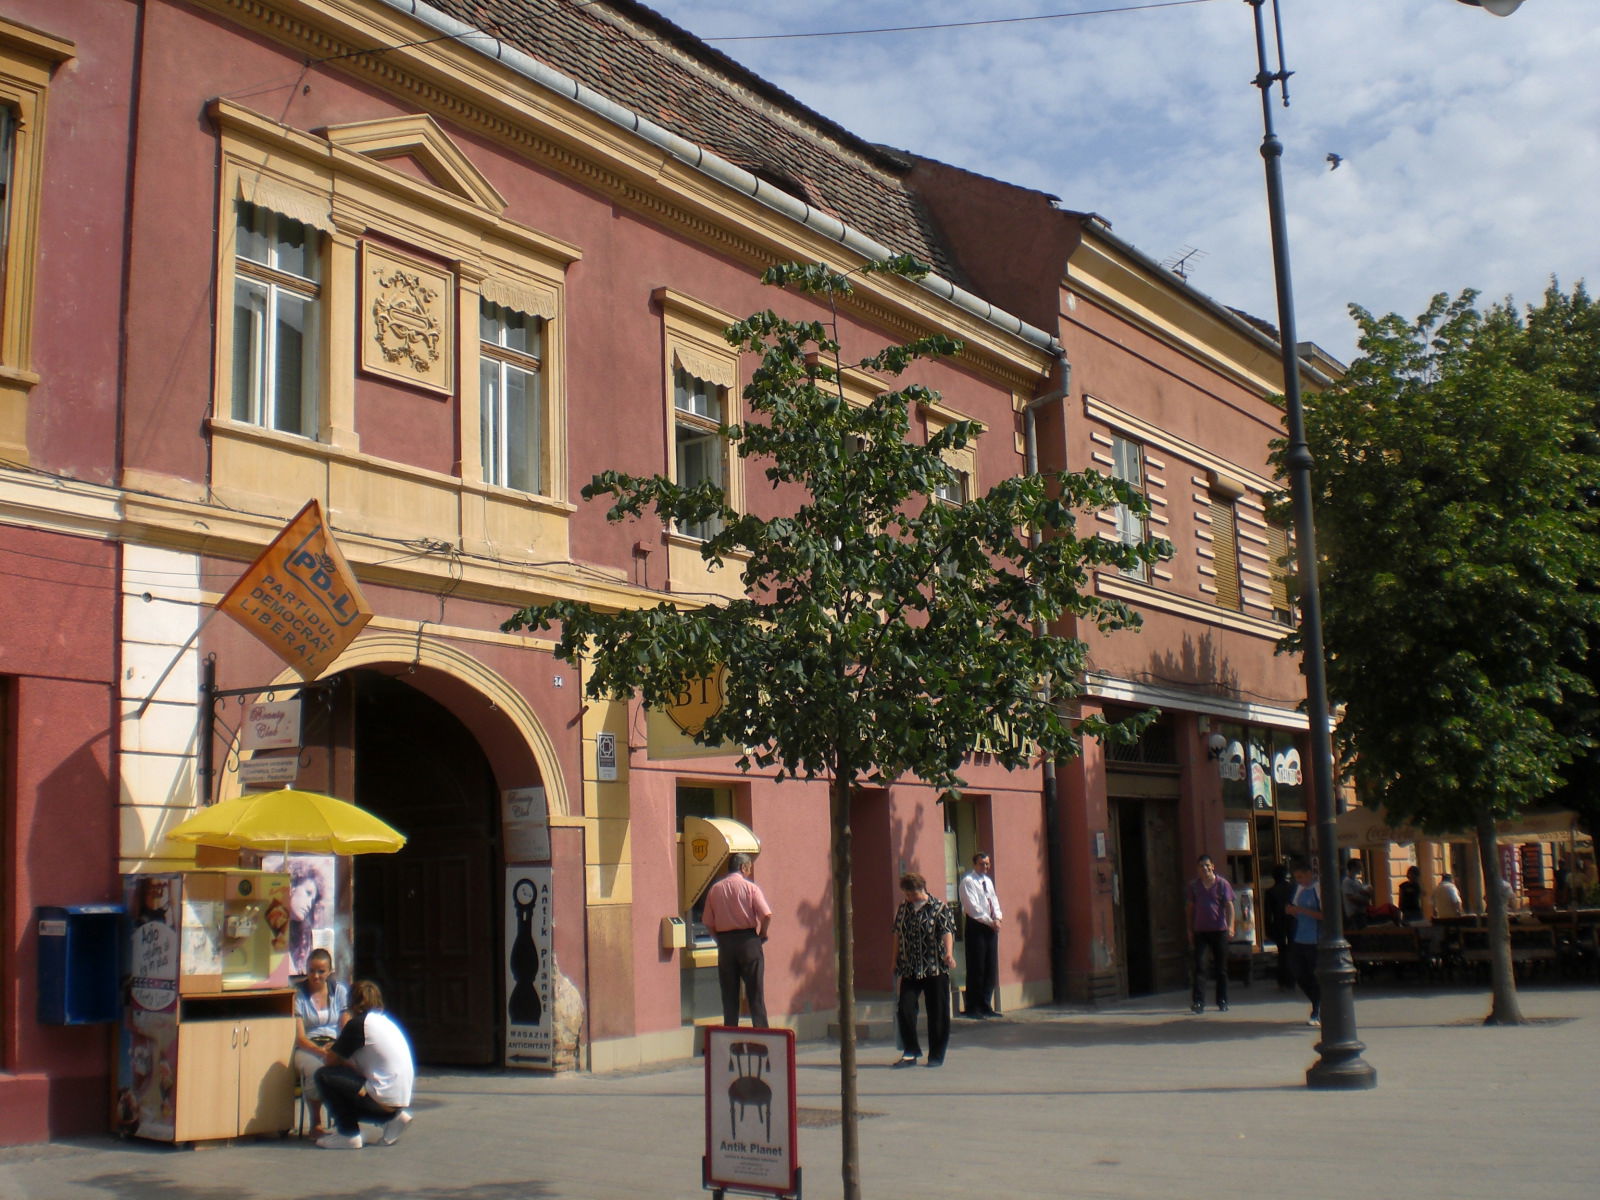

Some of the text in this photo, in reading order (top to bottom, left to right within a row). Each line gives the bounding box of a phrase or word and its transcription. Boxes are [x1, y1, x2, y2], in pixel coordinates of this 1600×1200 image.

[262, 575, 337, 645] PARTIDUL
[292, 550, 349, 617] PD-L
[240, 599, 318, 666] LIBERAL
[250, 587, 332, 653] DEMOCRAT
[540, 884, 549, 1013] Antik Planet
[510, 1031, 549, 1039] MAGAZIN
[720, 1140, 783, 1157] Antik Planet
